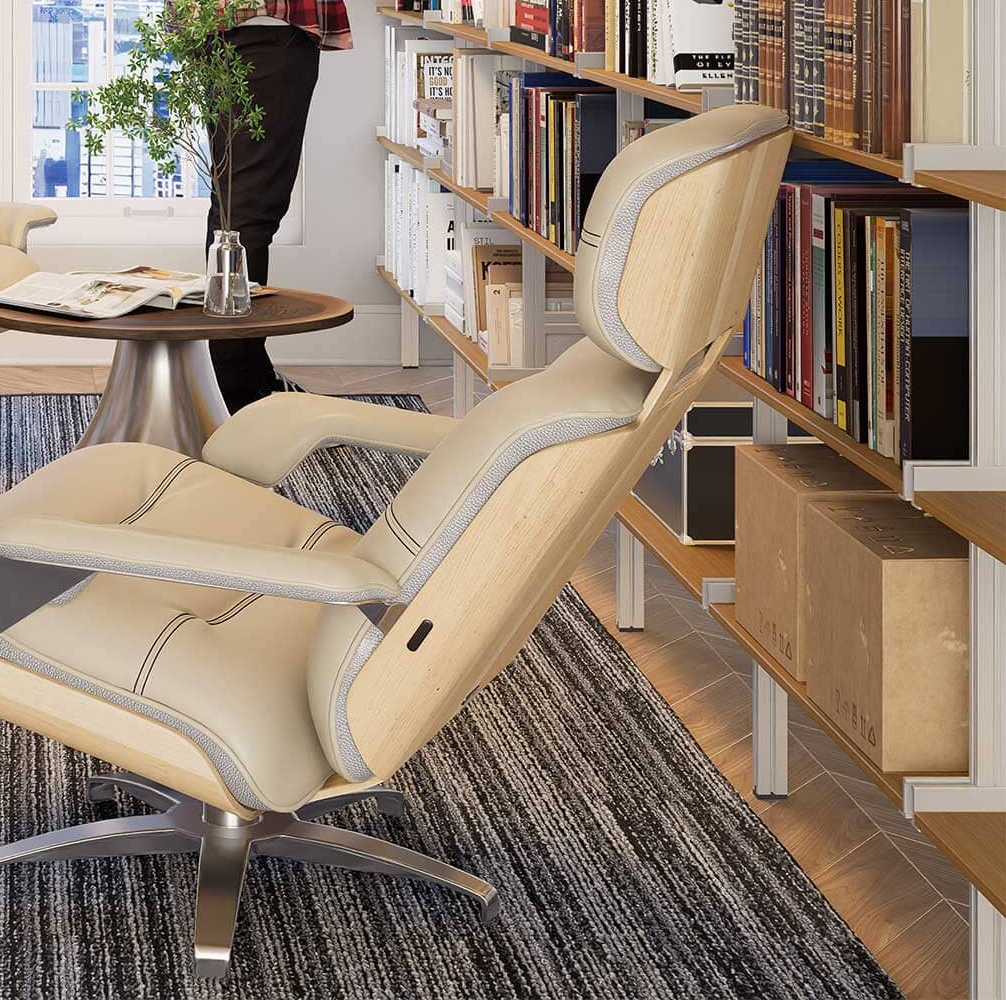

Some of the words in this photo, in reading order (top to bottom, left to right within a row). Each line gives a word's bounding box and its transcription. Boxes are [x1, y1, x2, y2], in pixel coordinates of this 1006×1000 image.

[428, 66, 443, 76] IT'S
[429, 77, 448, 86] GOOD
[429, 87, 443, 97] IT'S
[473, 237, 494, 246] STIL
[905, 298, 911, 314] OF
